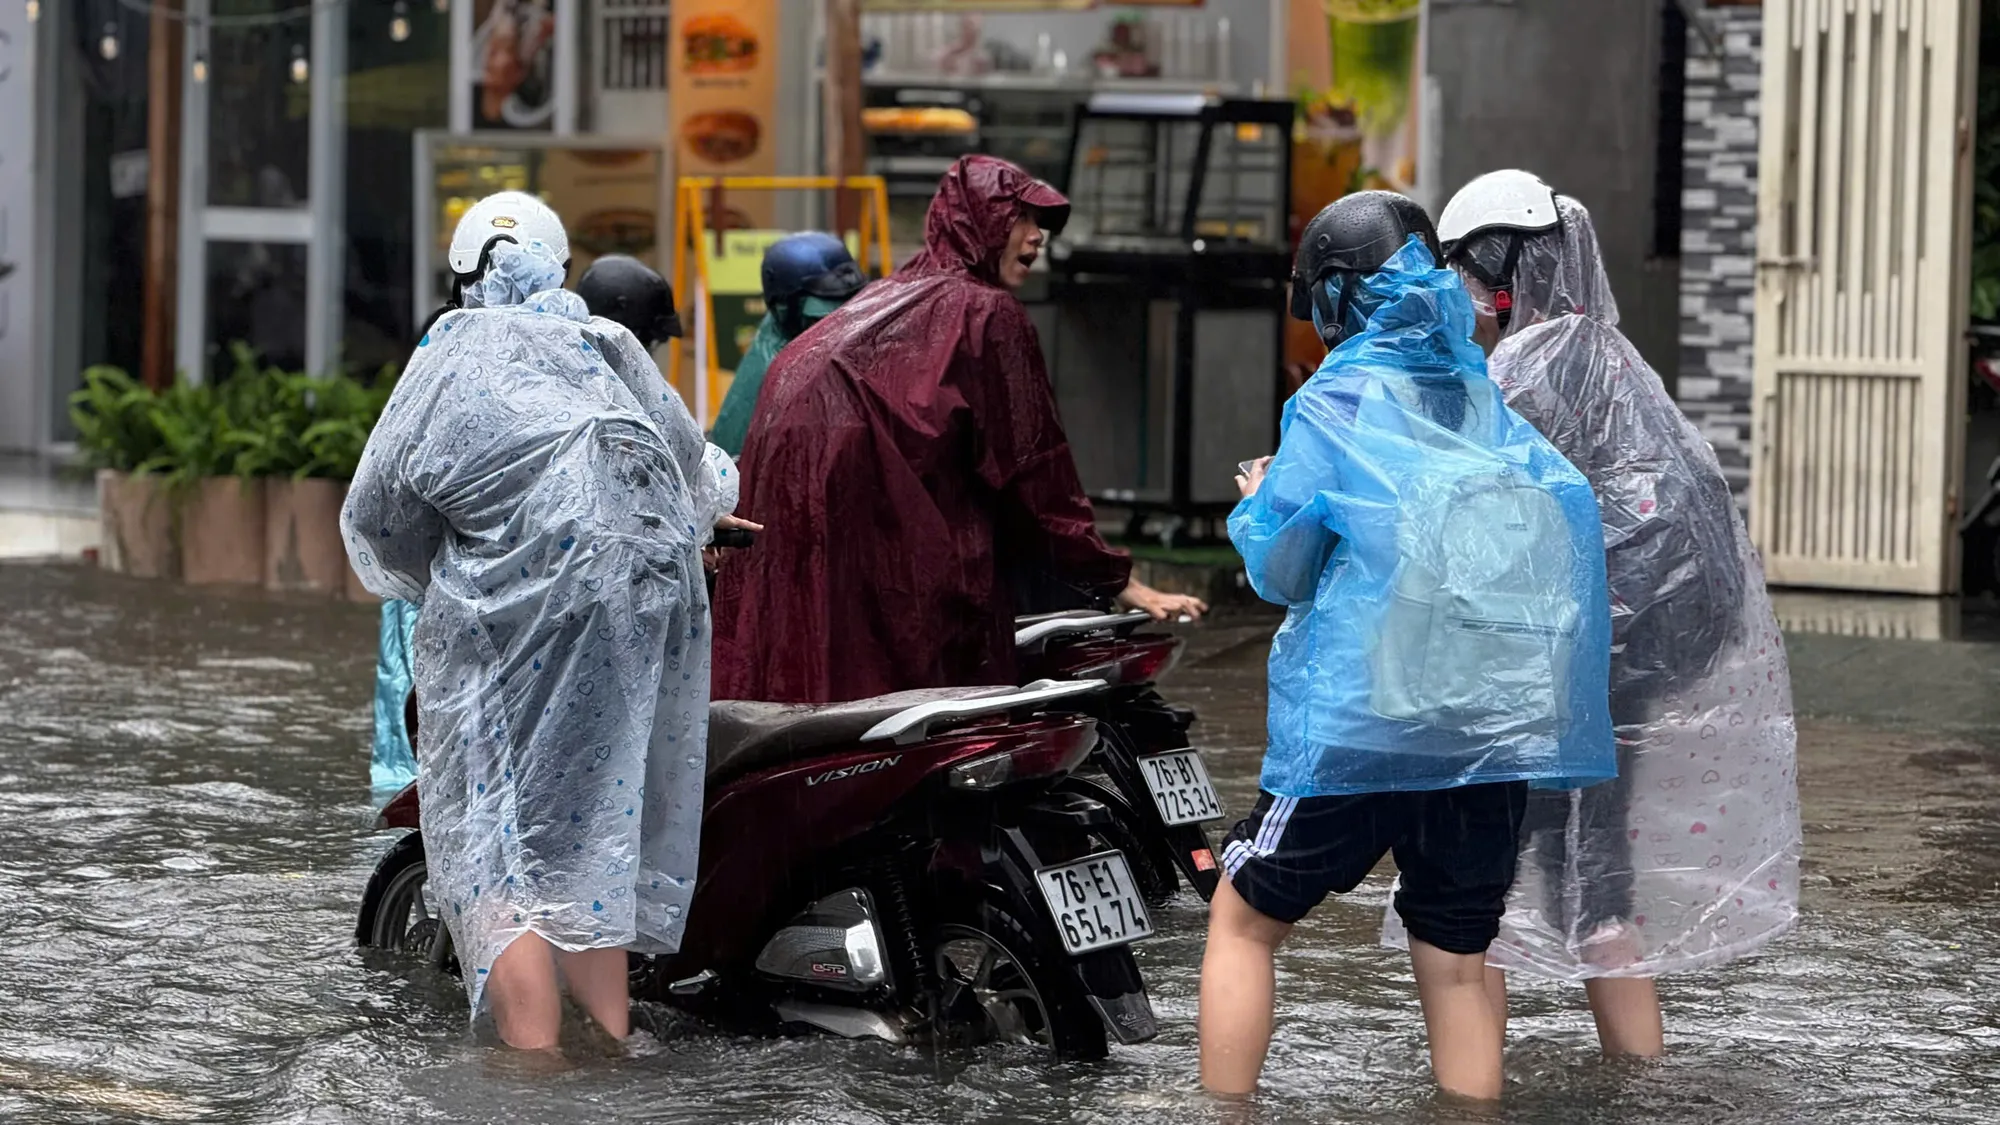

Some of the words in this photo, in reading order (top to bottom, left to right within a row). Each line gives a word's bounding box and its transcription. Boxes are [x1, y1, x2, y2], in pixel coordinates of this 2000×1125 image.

[805, 754, 902, 786] VISION
[1148, 755, 1199, 788] 76-B1
[1157, 786, 1218, 821] 725.34
[1050, 861, 1121, 908] 76-E1
[1061, 897, 1146, 947] 654.74
